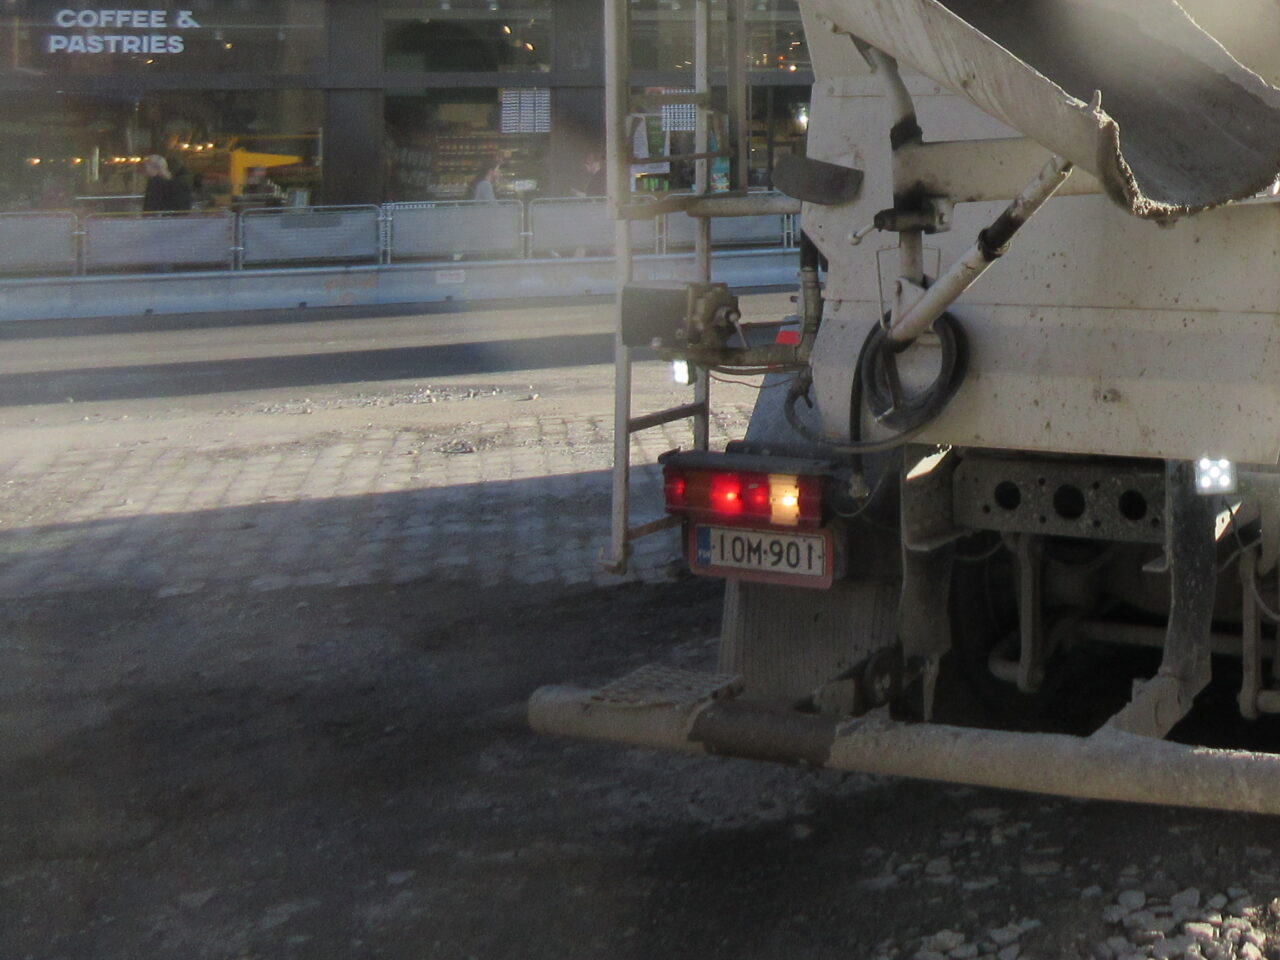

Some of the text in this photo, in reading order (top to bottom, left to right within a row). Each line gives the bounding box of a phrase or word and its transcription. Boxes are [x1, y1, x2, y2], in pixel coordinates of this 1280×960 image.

[55, 9, 201, 28] COFFEE &
[50, 35, 185, 54] PASTRIES
